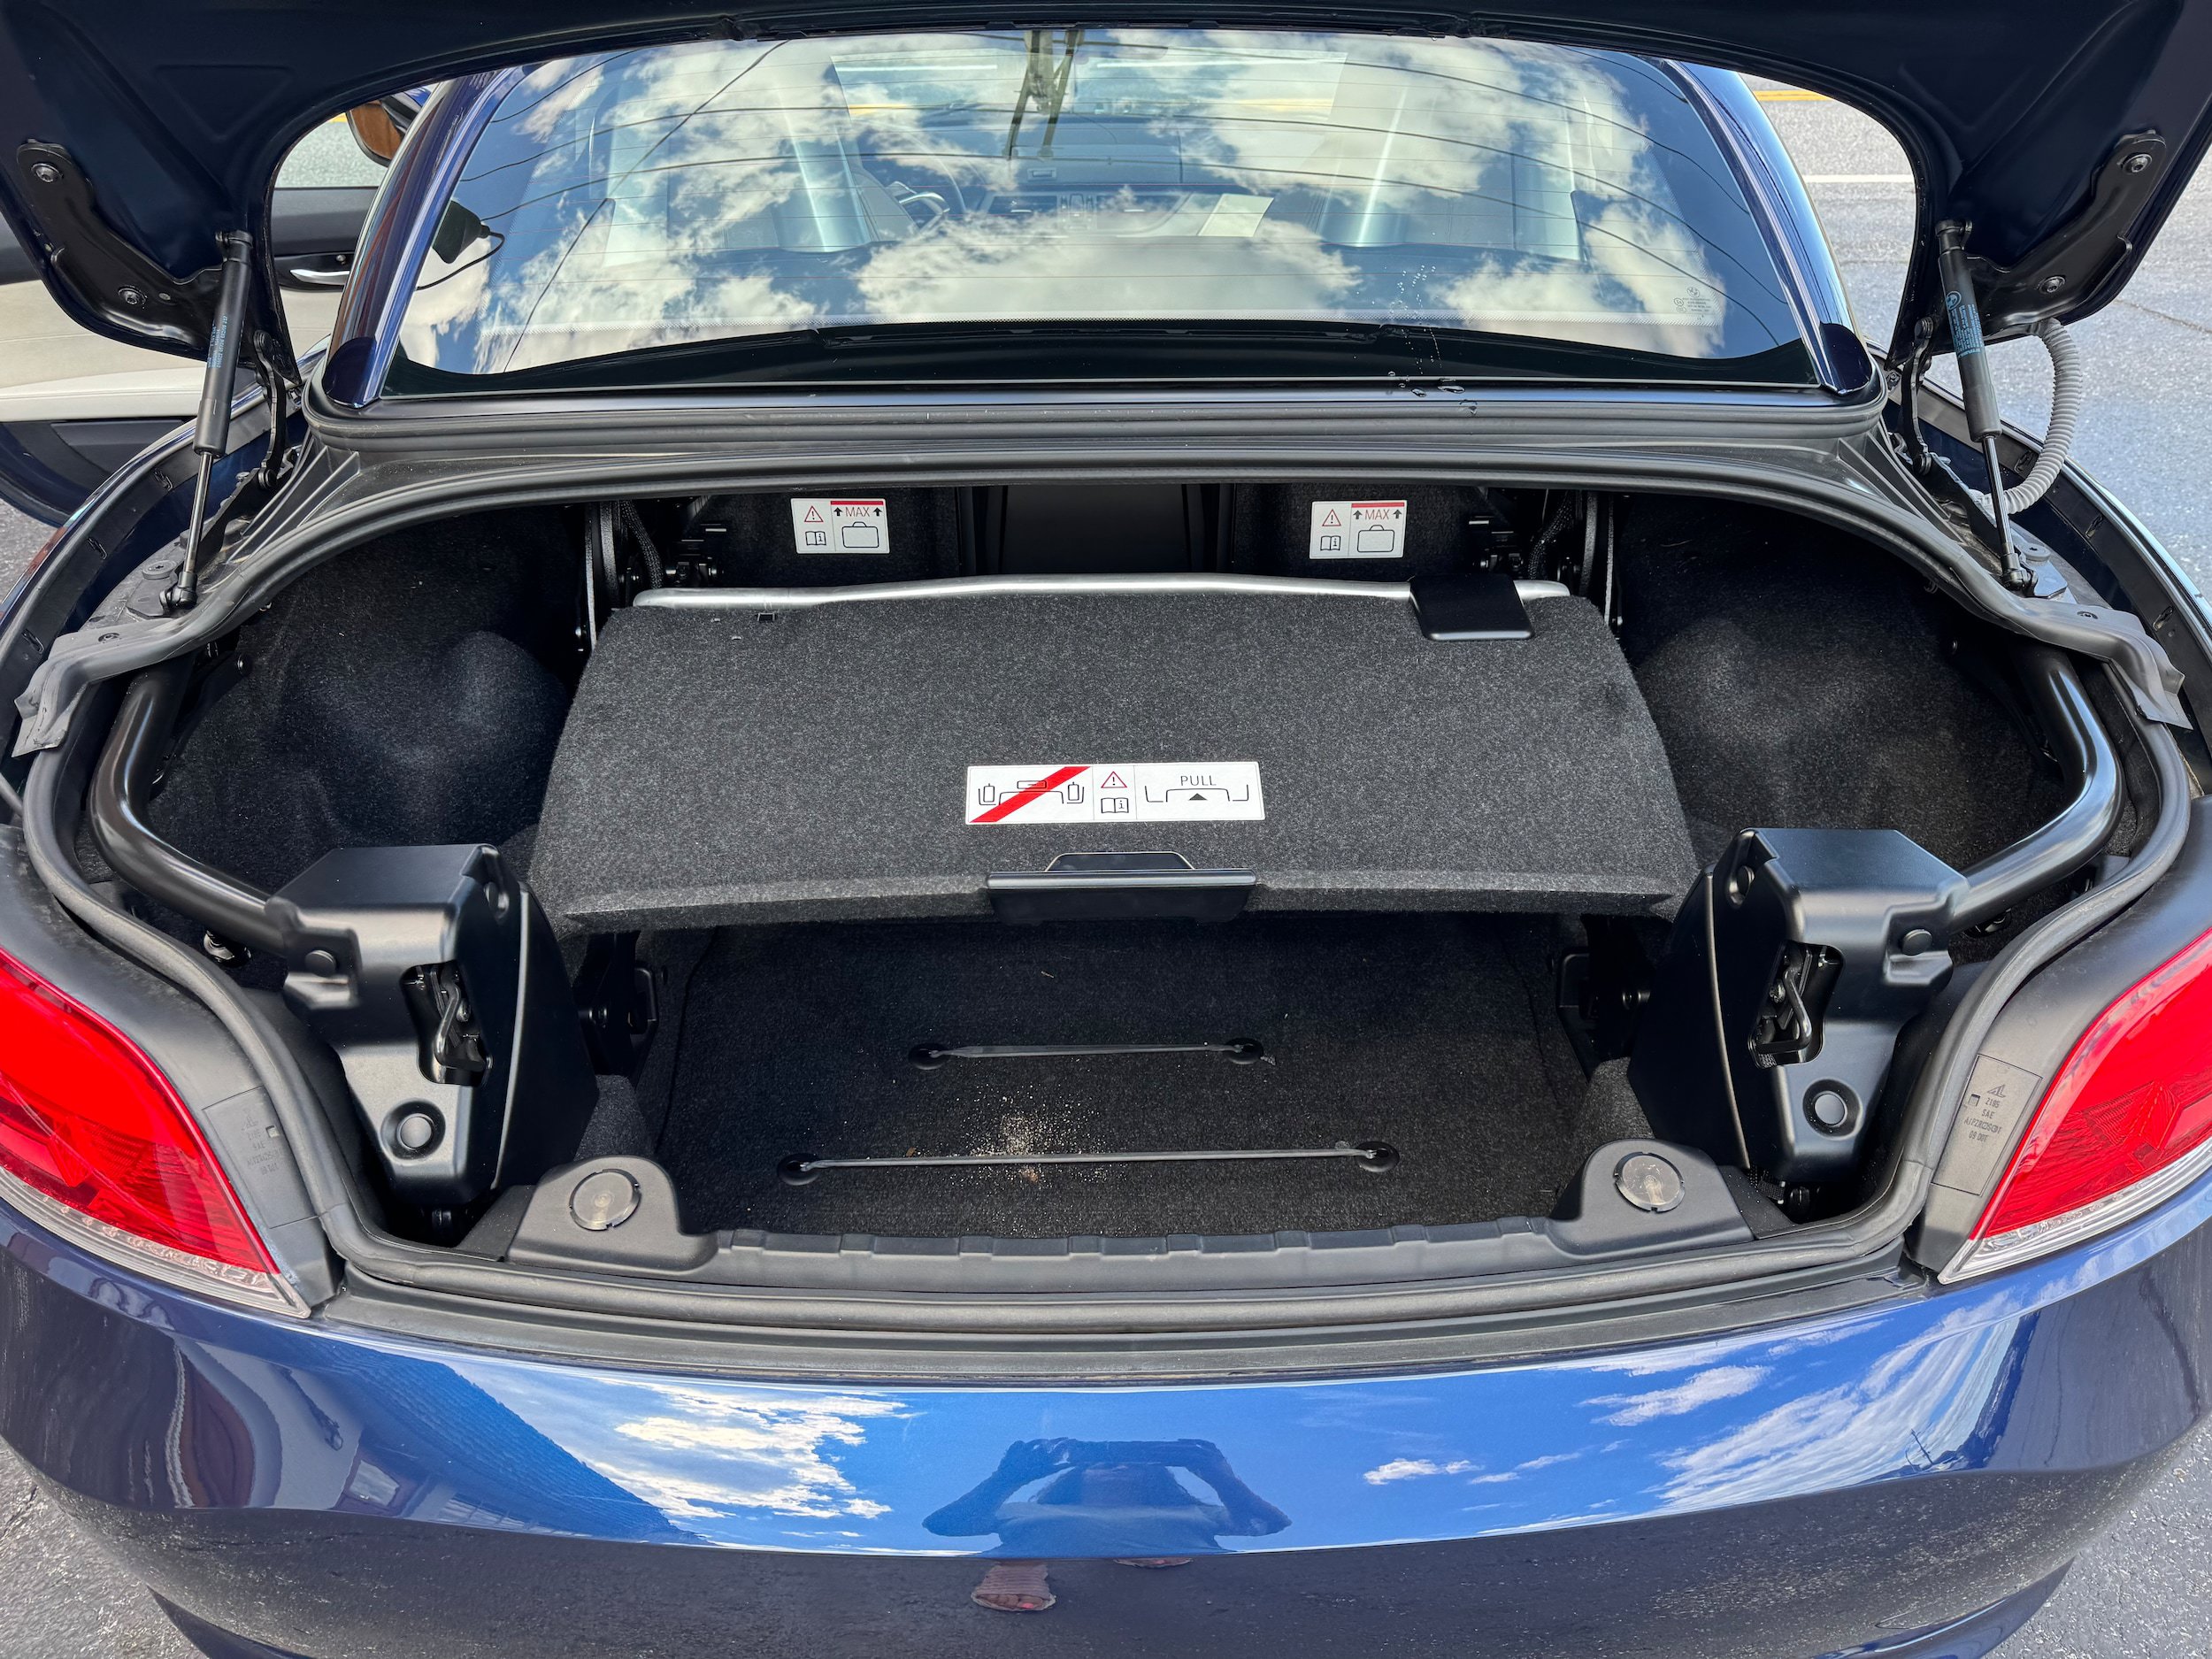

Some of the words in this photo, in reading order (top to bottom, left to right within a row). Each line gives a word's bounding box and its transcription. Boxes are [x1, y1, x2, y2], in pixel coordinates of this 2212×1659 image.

[845, 506, 871, 517] MAX
[1364, 509, 1390, 520] MAX
[1180, 774, 1217, 787] PULL
[1981, 1109, 1995, 1119] SAE
